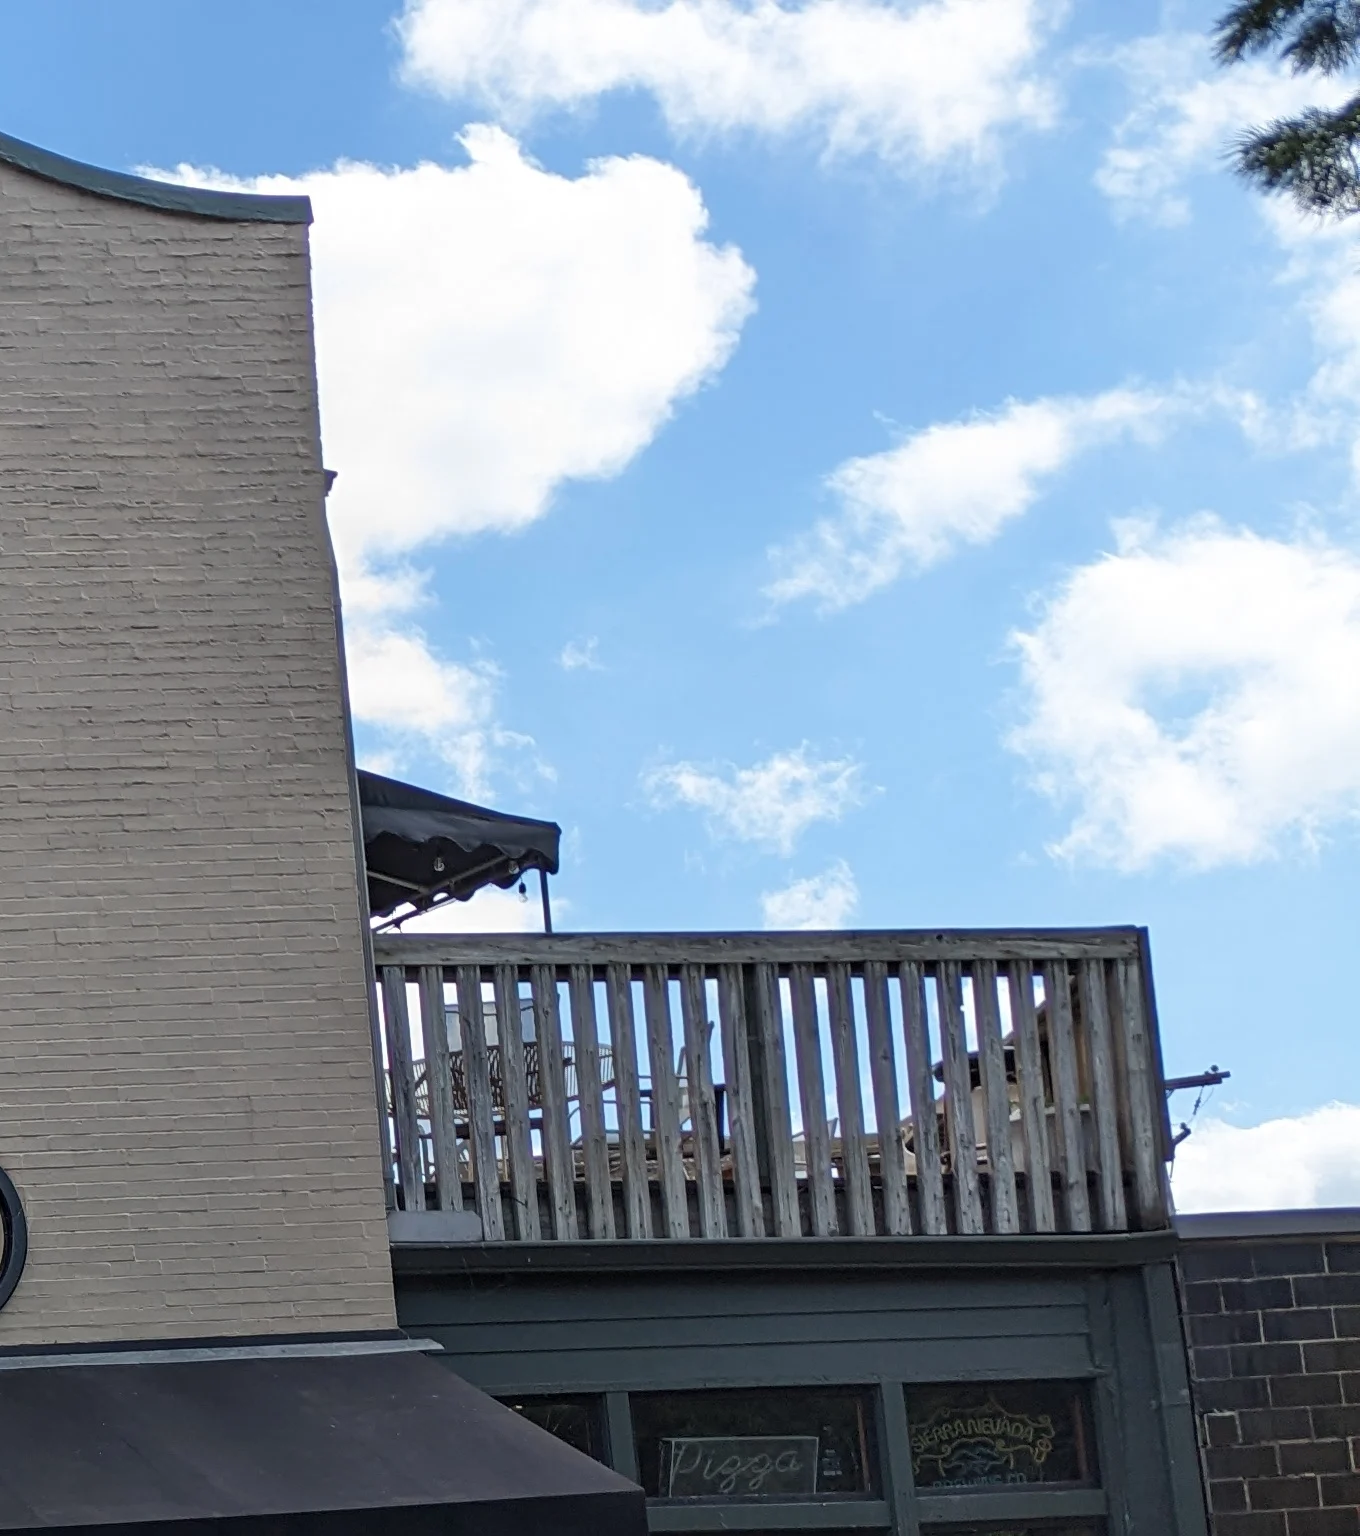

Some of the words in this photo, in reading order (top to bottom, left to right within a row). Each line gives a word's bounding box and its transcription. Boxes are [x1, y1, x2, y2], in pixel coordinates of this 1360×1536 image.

[910, 1419, 967, 1454] SIERRA
[966, 1417, 1036, 1444] NEVADA
[672, 1441, 804, 1494] Pizza
